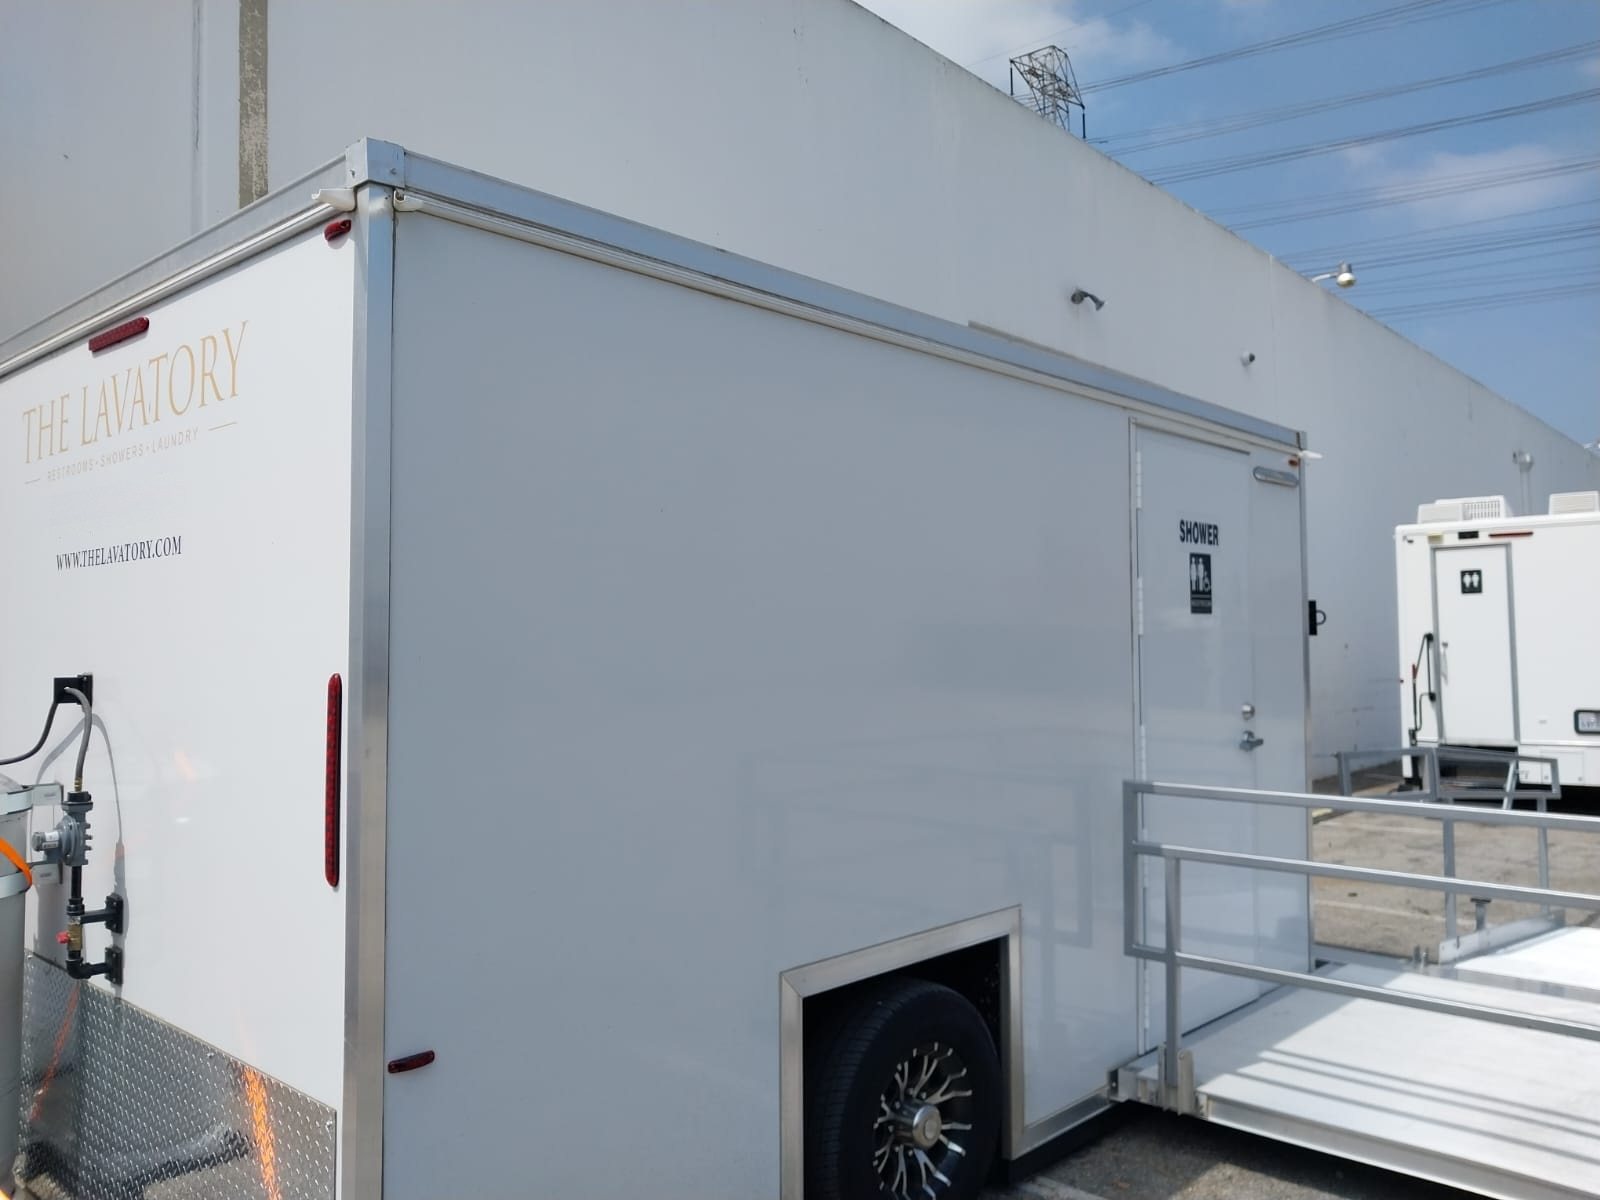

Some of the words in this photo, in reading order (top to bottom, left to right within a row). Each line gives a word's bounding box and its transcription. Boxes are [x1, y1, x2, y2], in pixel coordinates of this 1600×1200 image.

[22, 394, 70, 464] THE
[81, 320, 249, 447] LAVATORY
[100, 443, 144, 468] SHOWERS
[151, 427, 199, 453] LAUNDRY
[1179, 519, 1219, 546] SHOWER
[56, 535, 182, 571] WWW.THELAVATORY.COM
